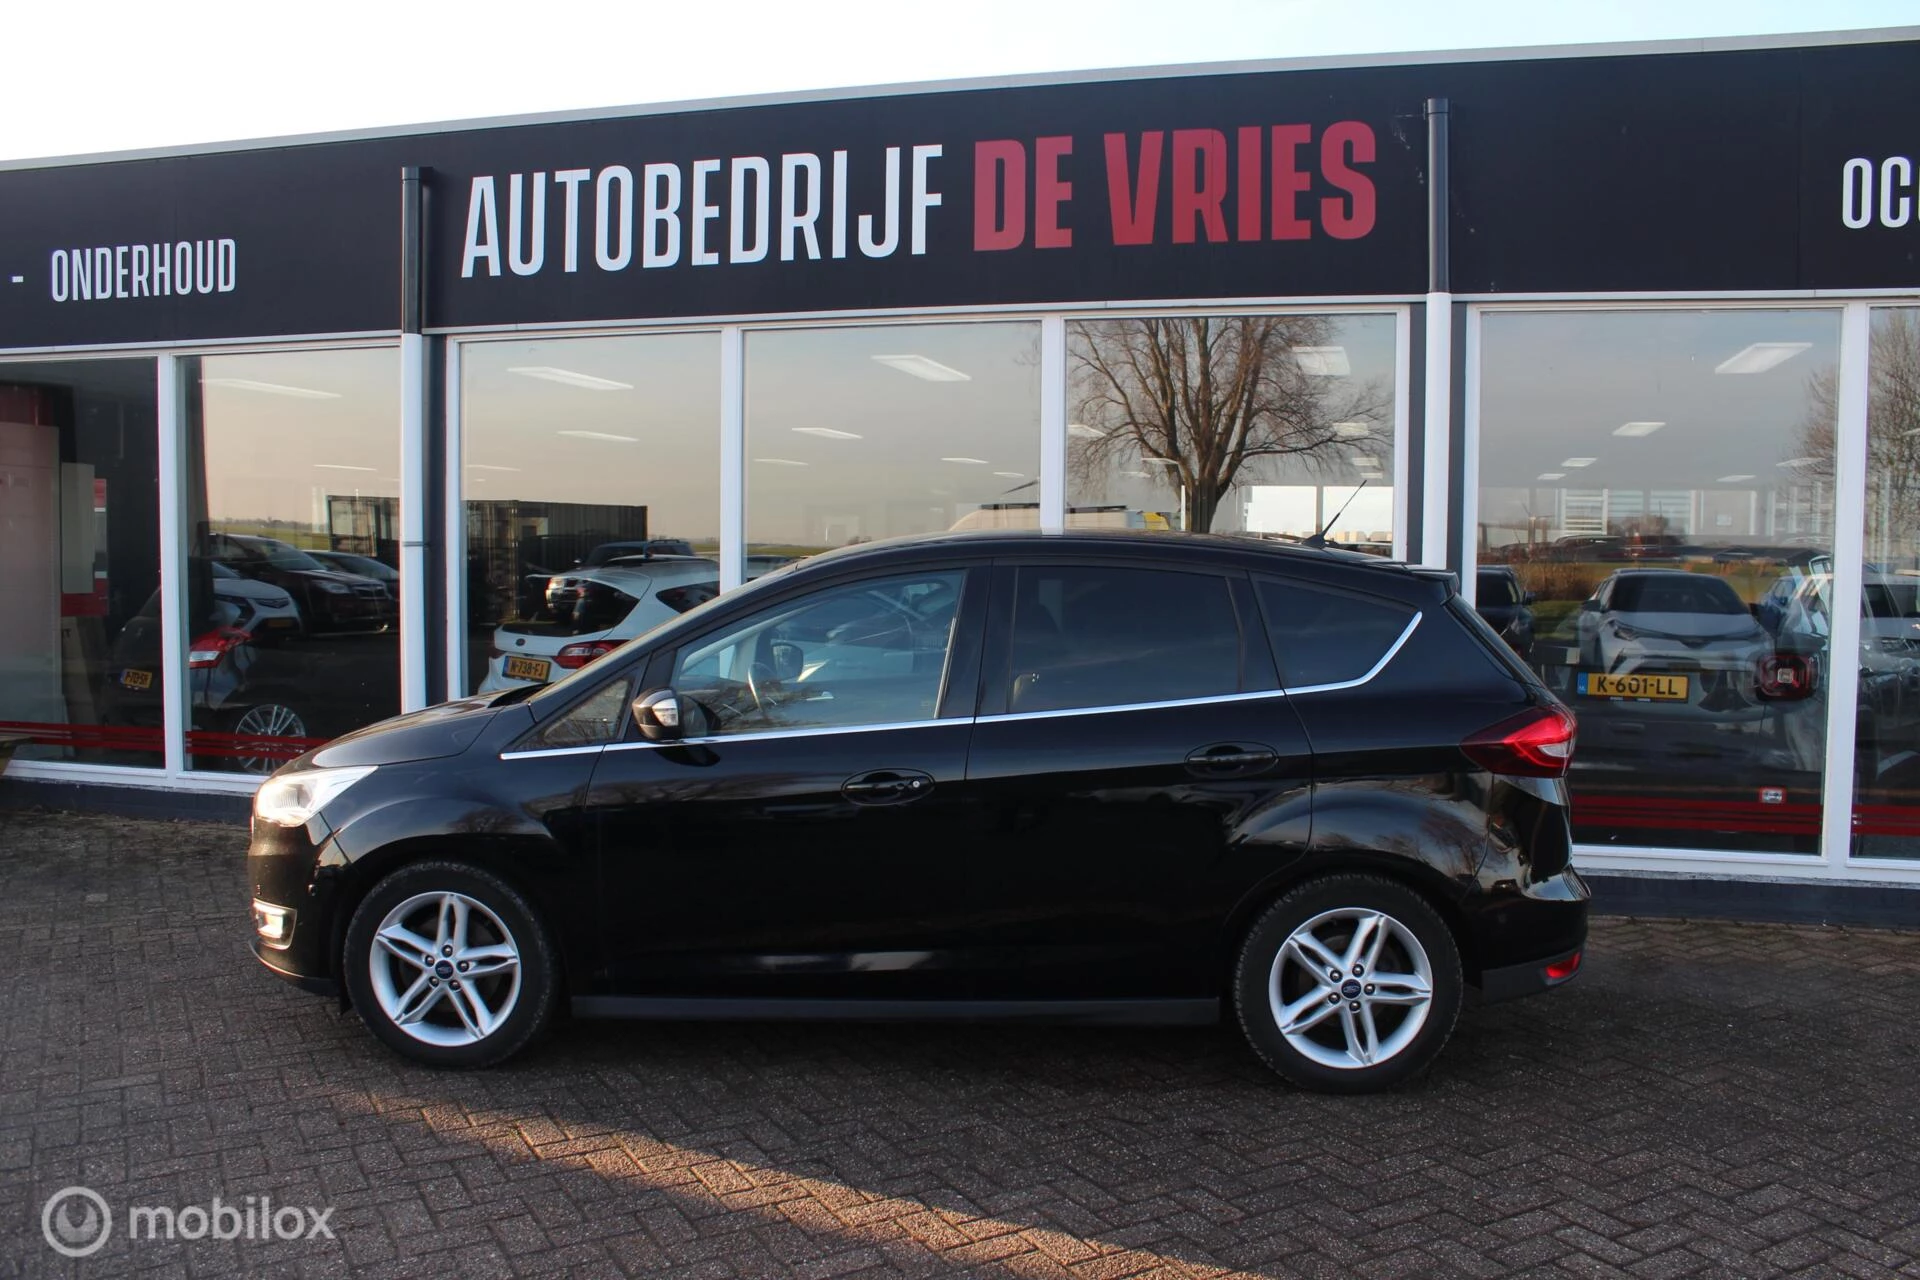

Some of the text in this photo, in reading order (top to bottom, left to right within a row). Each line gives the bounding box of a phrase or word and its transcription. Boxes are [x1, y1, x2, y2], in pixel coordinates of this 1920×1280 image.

[461, 120, 1377, 279] AUTOBEDRIJF DE VRIES
[1842, 156, 1920, 229] OC
[51, 238, 236, 302] ONDERHOUD
[1597, 675, 1678, 695] K-601-LL
